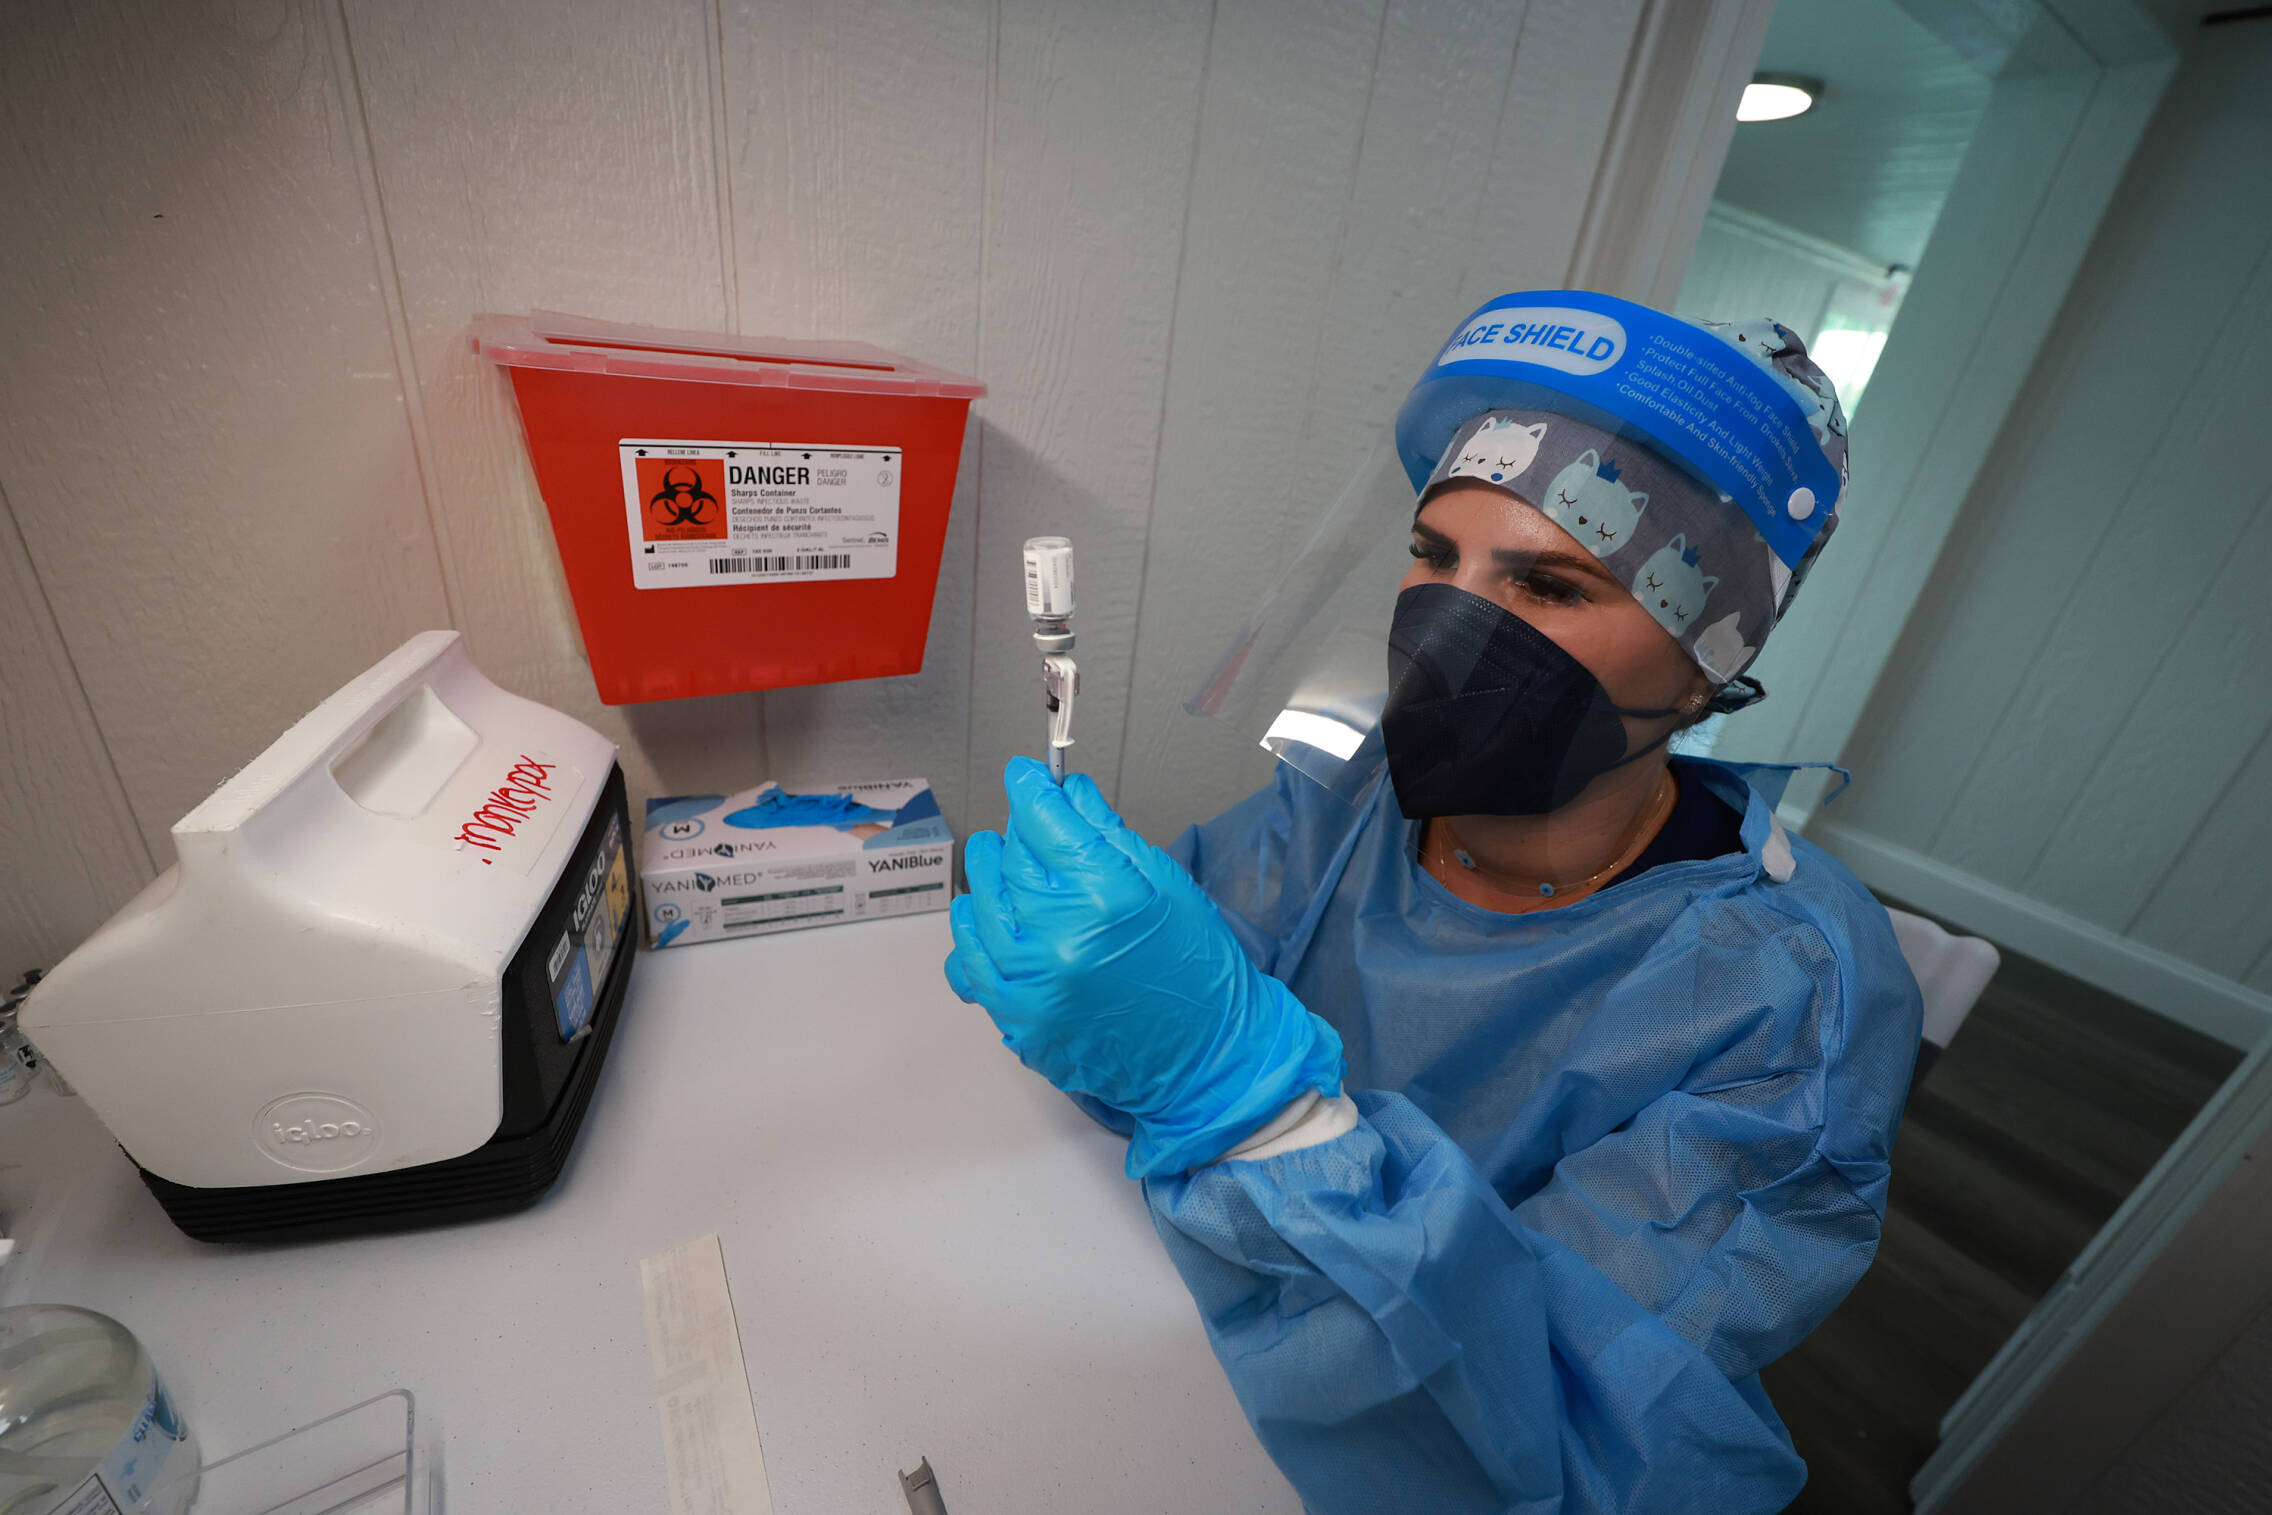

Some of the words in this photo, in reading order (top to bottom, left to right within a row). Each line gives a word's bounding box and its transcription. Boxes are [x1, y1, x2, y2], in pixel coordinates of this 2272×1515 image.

[1503, 323, 1614, 361] SHIELD
[1645, 347, 1687, 374] Protect
[1687, 367, 1710, 386] Full
[1708, 381, 1732, 404] Face
[1733, 401, 1758, 425] From
[1619, 384, 1686, 425] Comfortable
[1686, 422, 1708, 441] And
[1628, 372, 1660, 392] Good
[1660, 387, 1708, 424] Elasticity
[1708, 419, 1729, 440] And
[1729, 435, 1753, 461] Light
[729, 466, 810, 485] DANGER
[816, 469, 848, 478] PELIGRO
[816, 478, 847, 486] DANGER
[731, 489, 757, 498] Sharps
[760, 489, 796, 497] Container
[732, 507, 773, 515] Contenedor
[809, 506, 842, 514] Cortantes
[733, 524, 769, 533] Récipient
[771, 524, 780, 532] de
[783, 523, 811, 532] sécurité
[868, 855, 943, 873] YANIBlue
[662, 909, 673, 918] M
[273, 1118, 361, 1146] igloo
